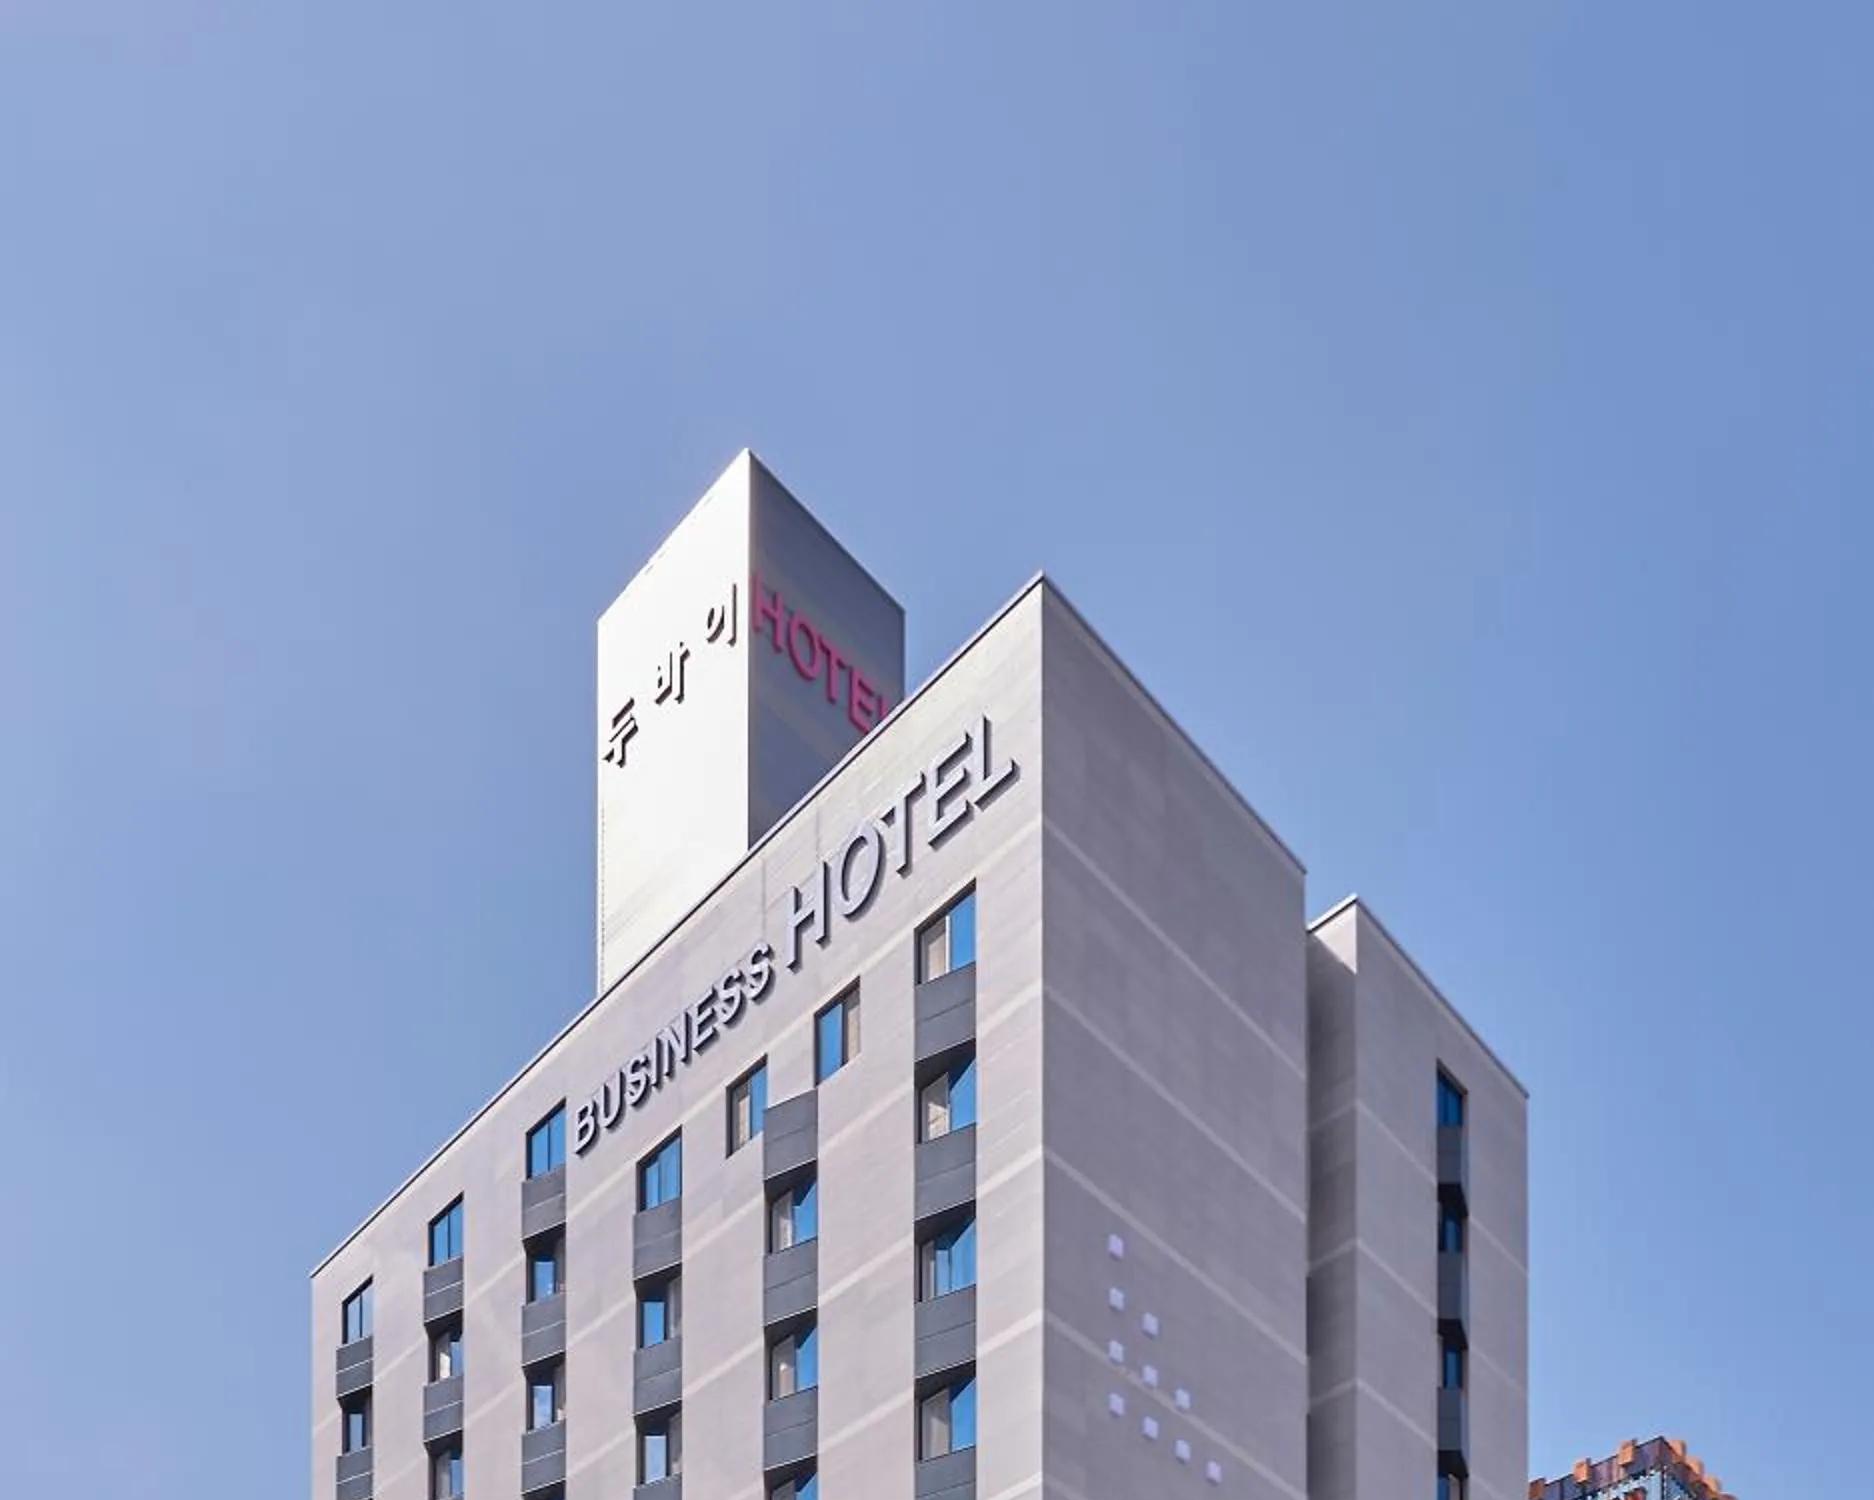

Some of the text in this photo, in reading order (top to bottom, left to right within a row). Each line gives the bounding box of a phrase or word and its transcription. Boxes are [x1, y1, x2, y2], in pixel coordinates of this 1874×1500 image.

[603, 583, 738, 768] 두바이
[575, 714, 1021, 1155] BUSINESS HOTEL
